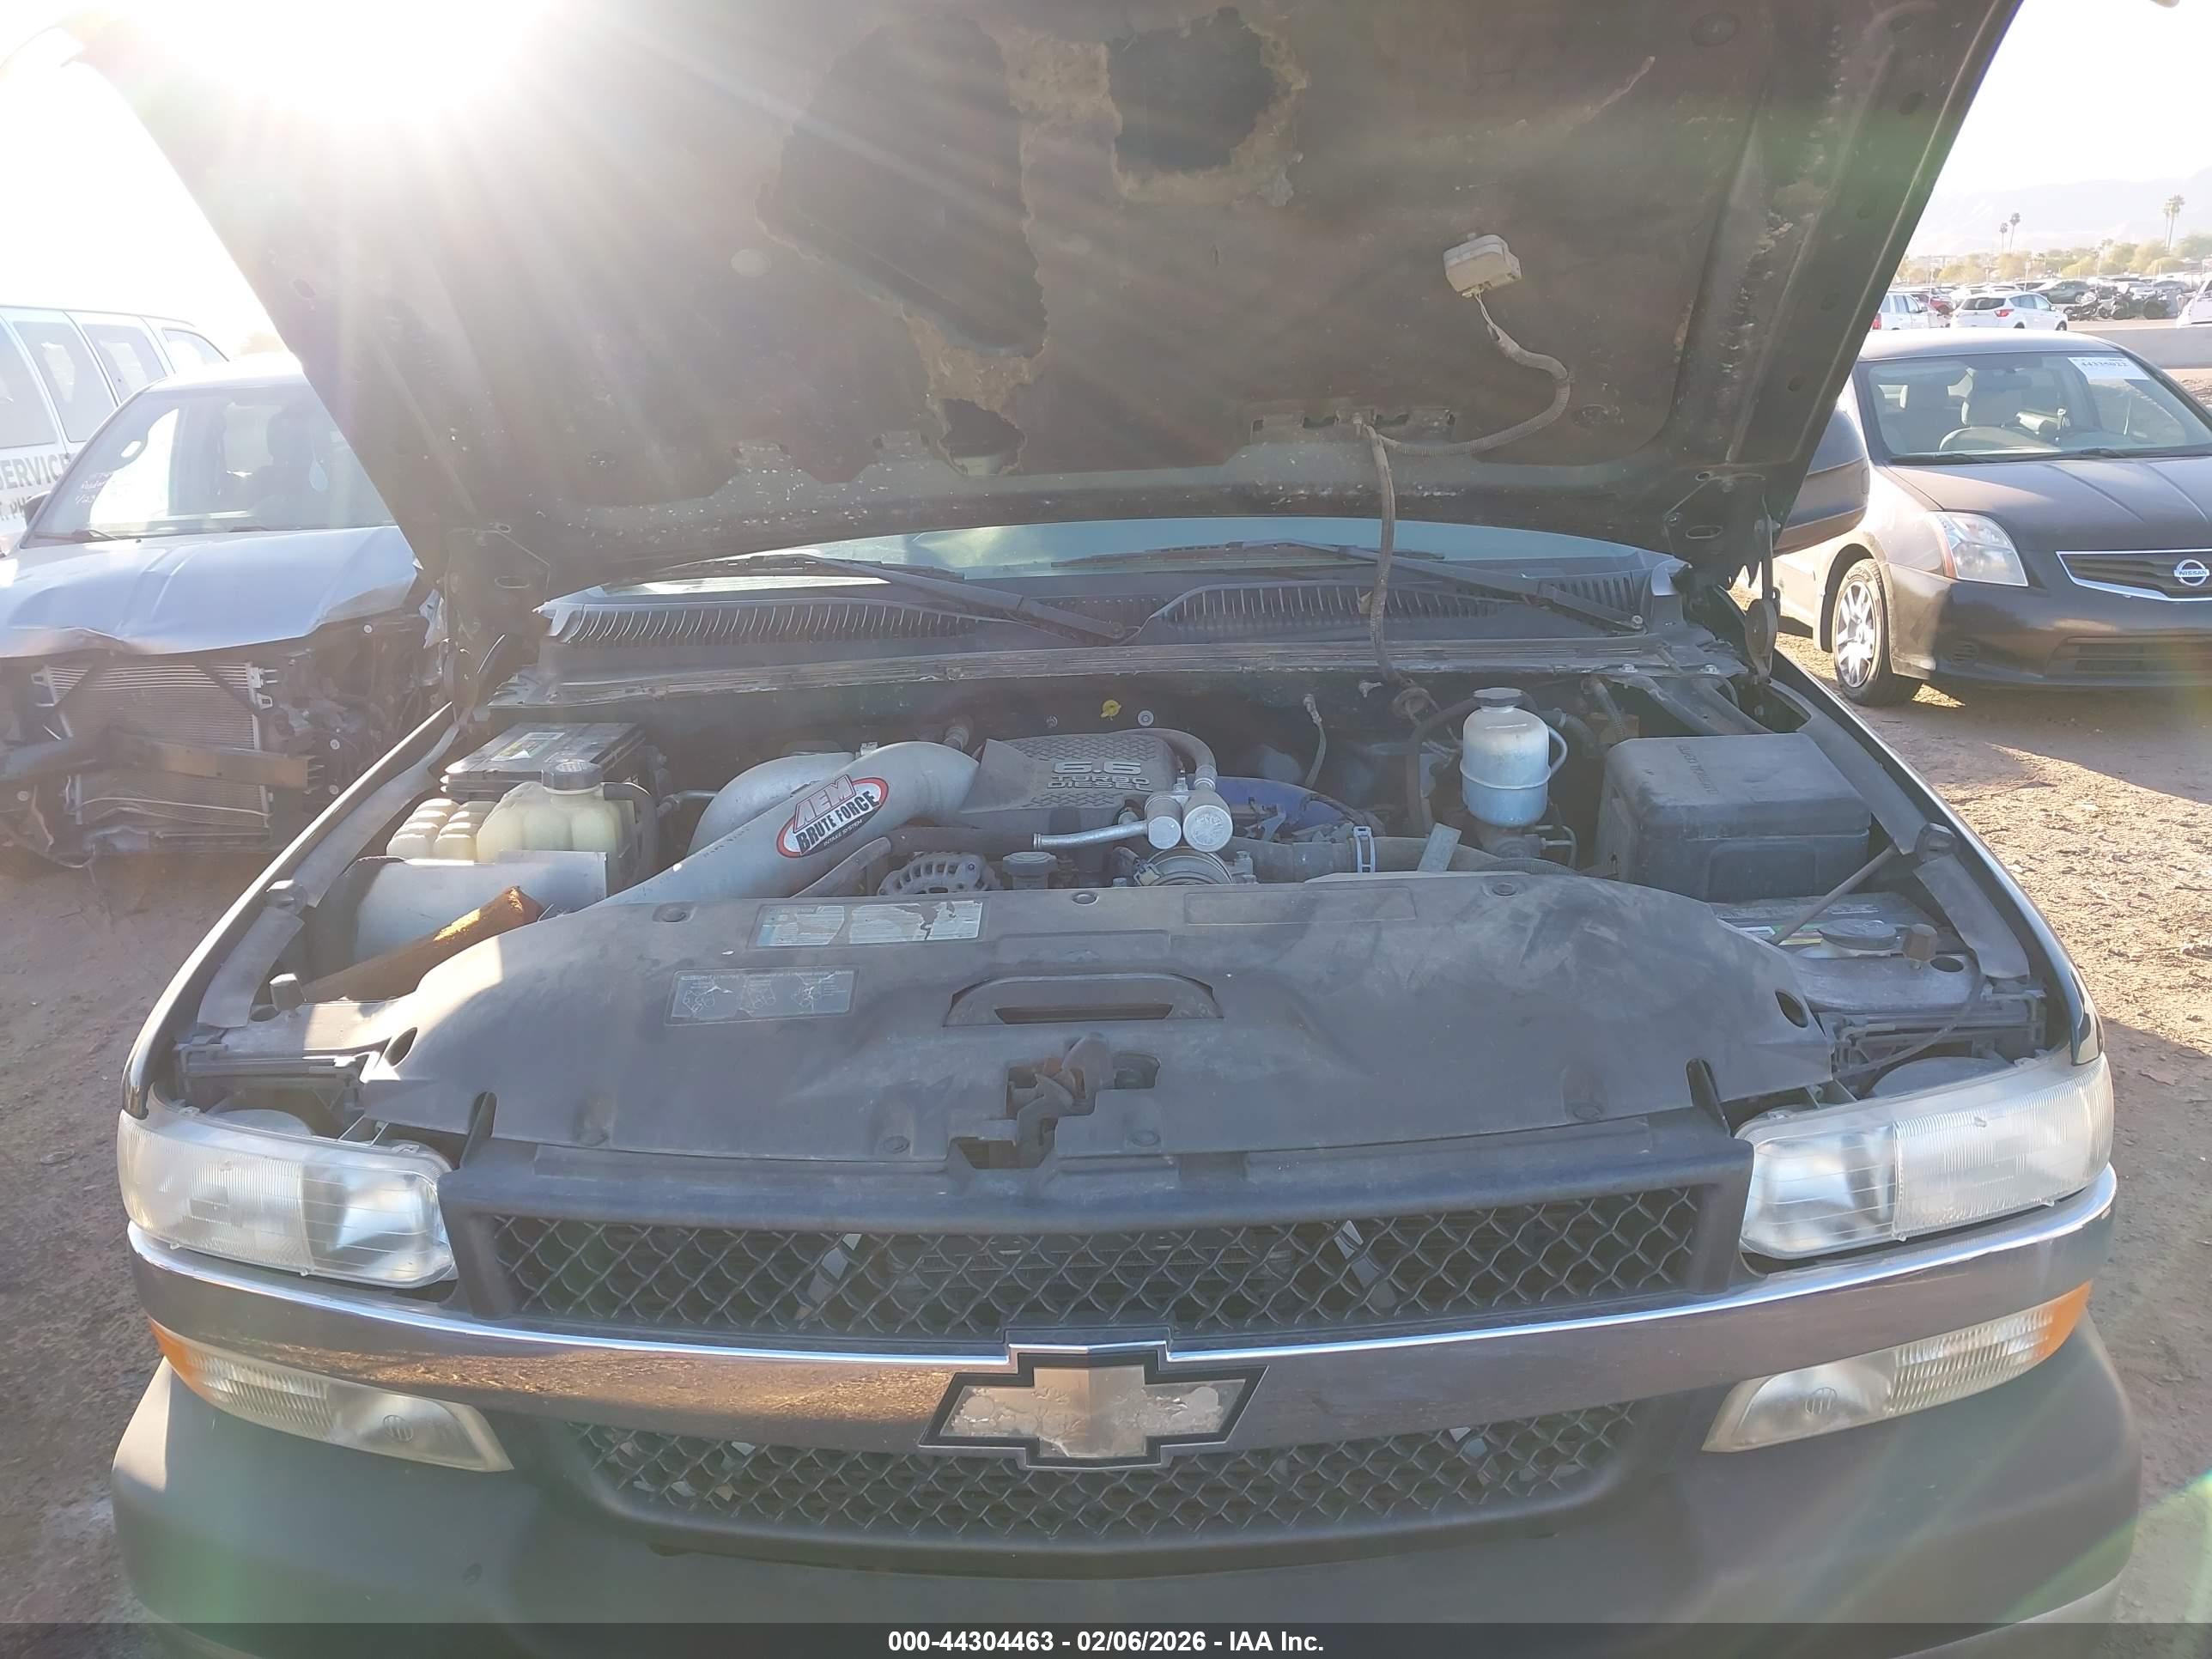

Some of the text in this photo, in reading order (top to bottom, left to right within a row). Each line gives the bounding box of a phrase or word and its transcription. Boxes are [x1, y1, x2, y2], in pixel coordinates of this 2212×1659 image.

[1053, 761, 1141, 775] 6.6
[1047, 781, 1153, 793] DIESEL
[1051, 775, 1151, 785] TURBO
[794, 775, 856, 833] AEM
[795, 790, 880, 855] BRUTE FORCE
[823, 818, 863, 847] INTAKE SYSTEM
